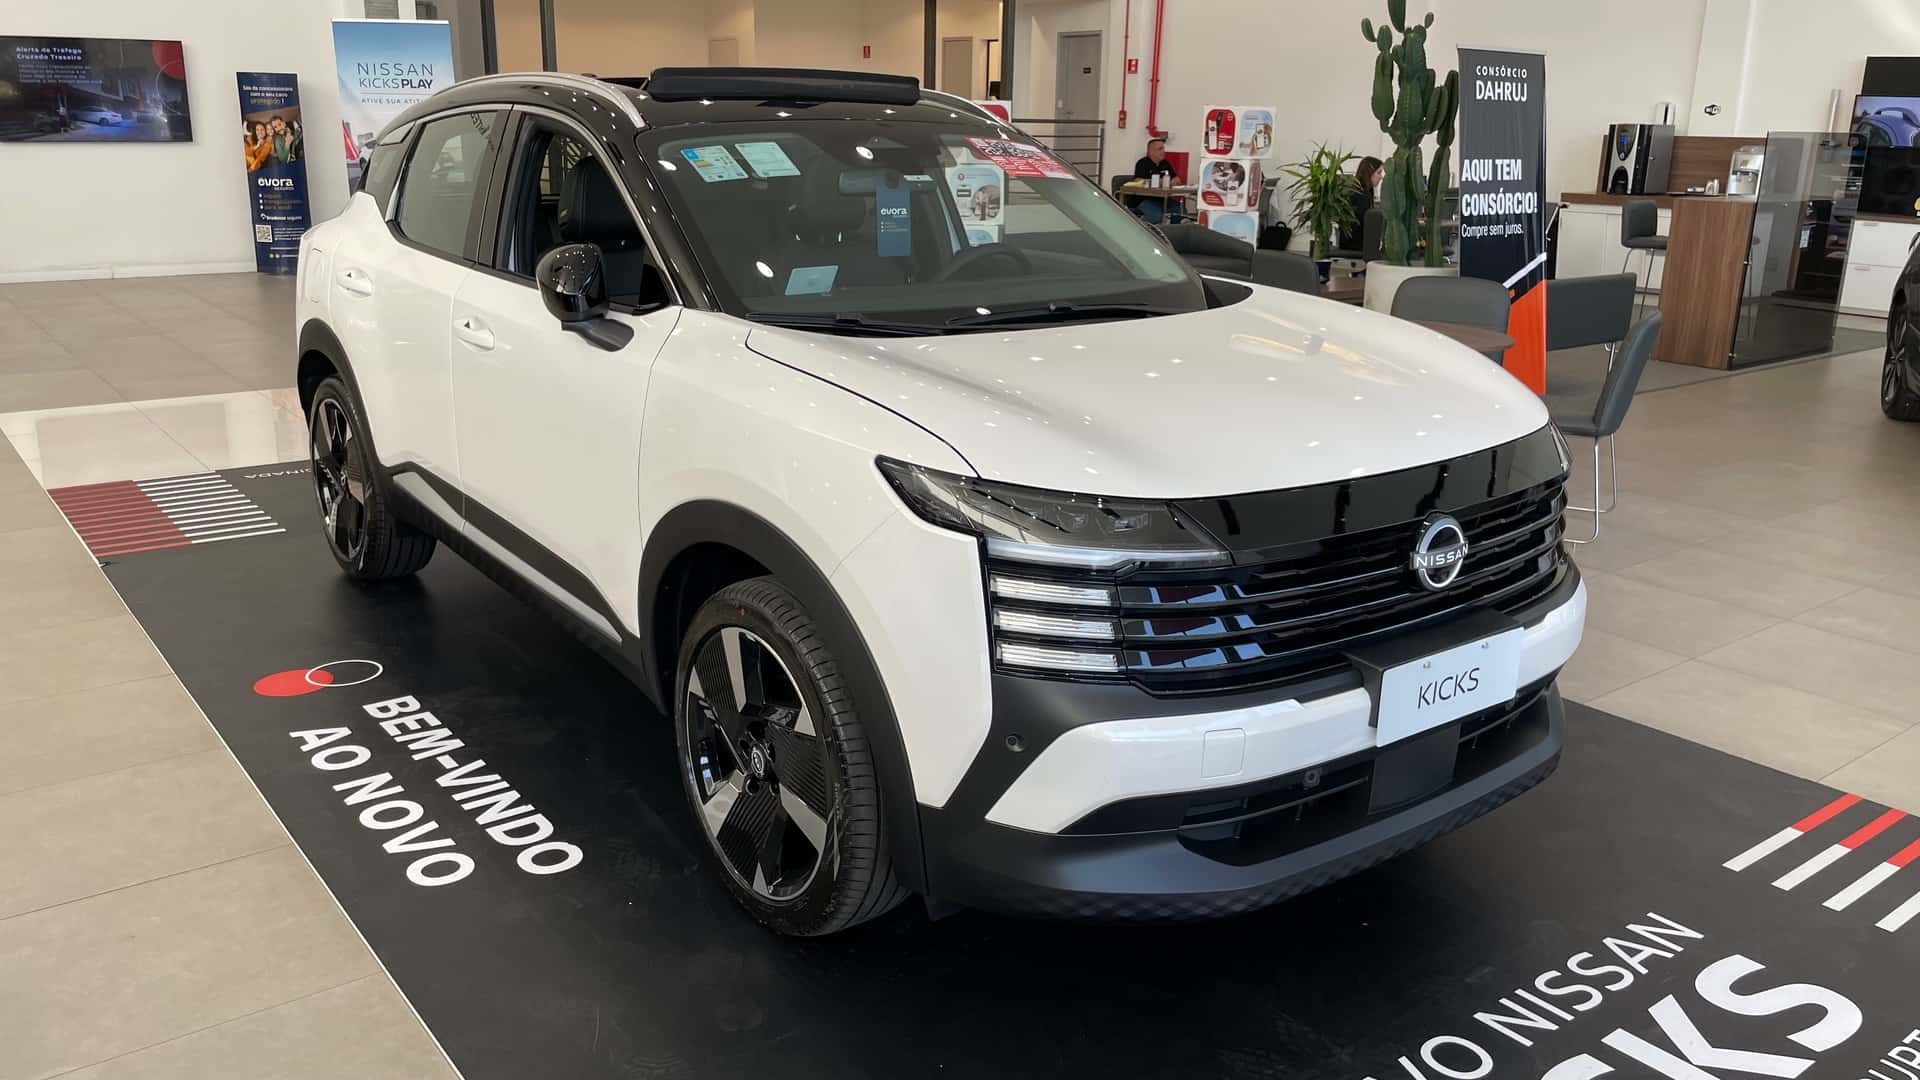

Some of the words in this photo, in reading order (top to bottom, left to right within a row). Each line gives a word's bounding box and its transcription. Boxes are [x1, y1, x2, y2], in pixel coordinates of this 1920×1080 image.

[357, 62, 433, 76] NISSAN
[1476, 65, 1528, 79] CONSÓRCIO
[1475, 79, 1528, 102] DAHRUJ
[1461, 159, 1493, 184] AQUI
[1495, 159, 1522, 181] TEM
[1461, 187, 1538, 217] CONSÓRCIO!
[1461, 223, 1488, 239] Compre
[1489, 224, 1504, 236] sem
[1416, 543, 1469, 568] NISSAN
[1417, 667, 1480, 710] KICKS
[362, 695, 584, 875] BEM-VINDO
[289, 726, 371, 771] AO
[332, 771, 475, 887] NOVO
[1473, 912, 1704, 1047] NISSAN
